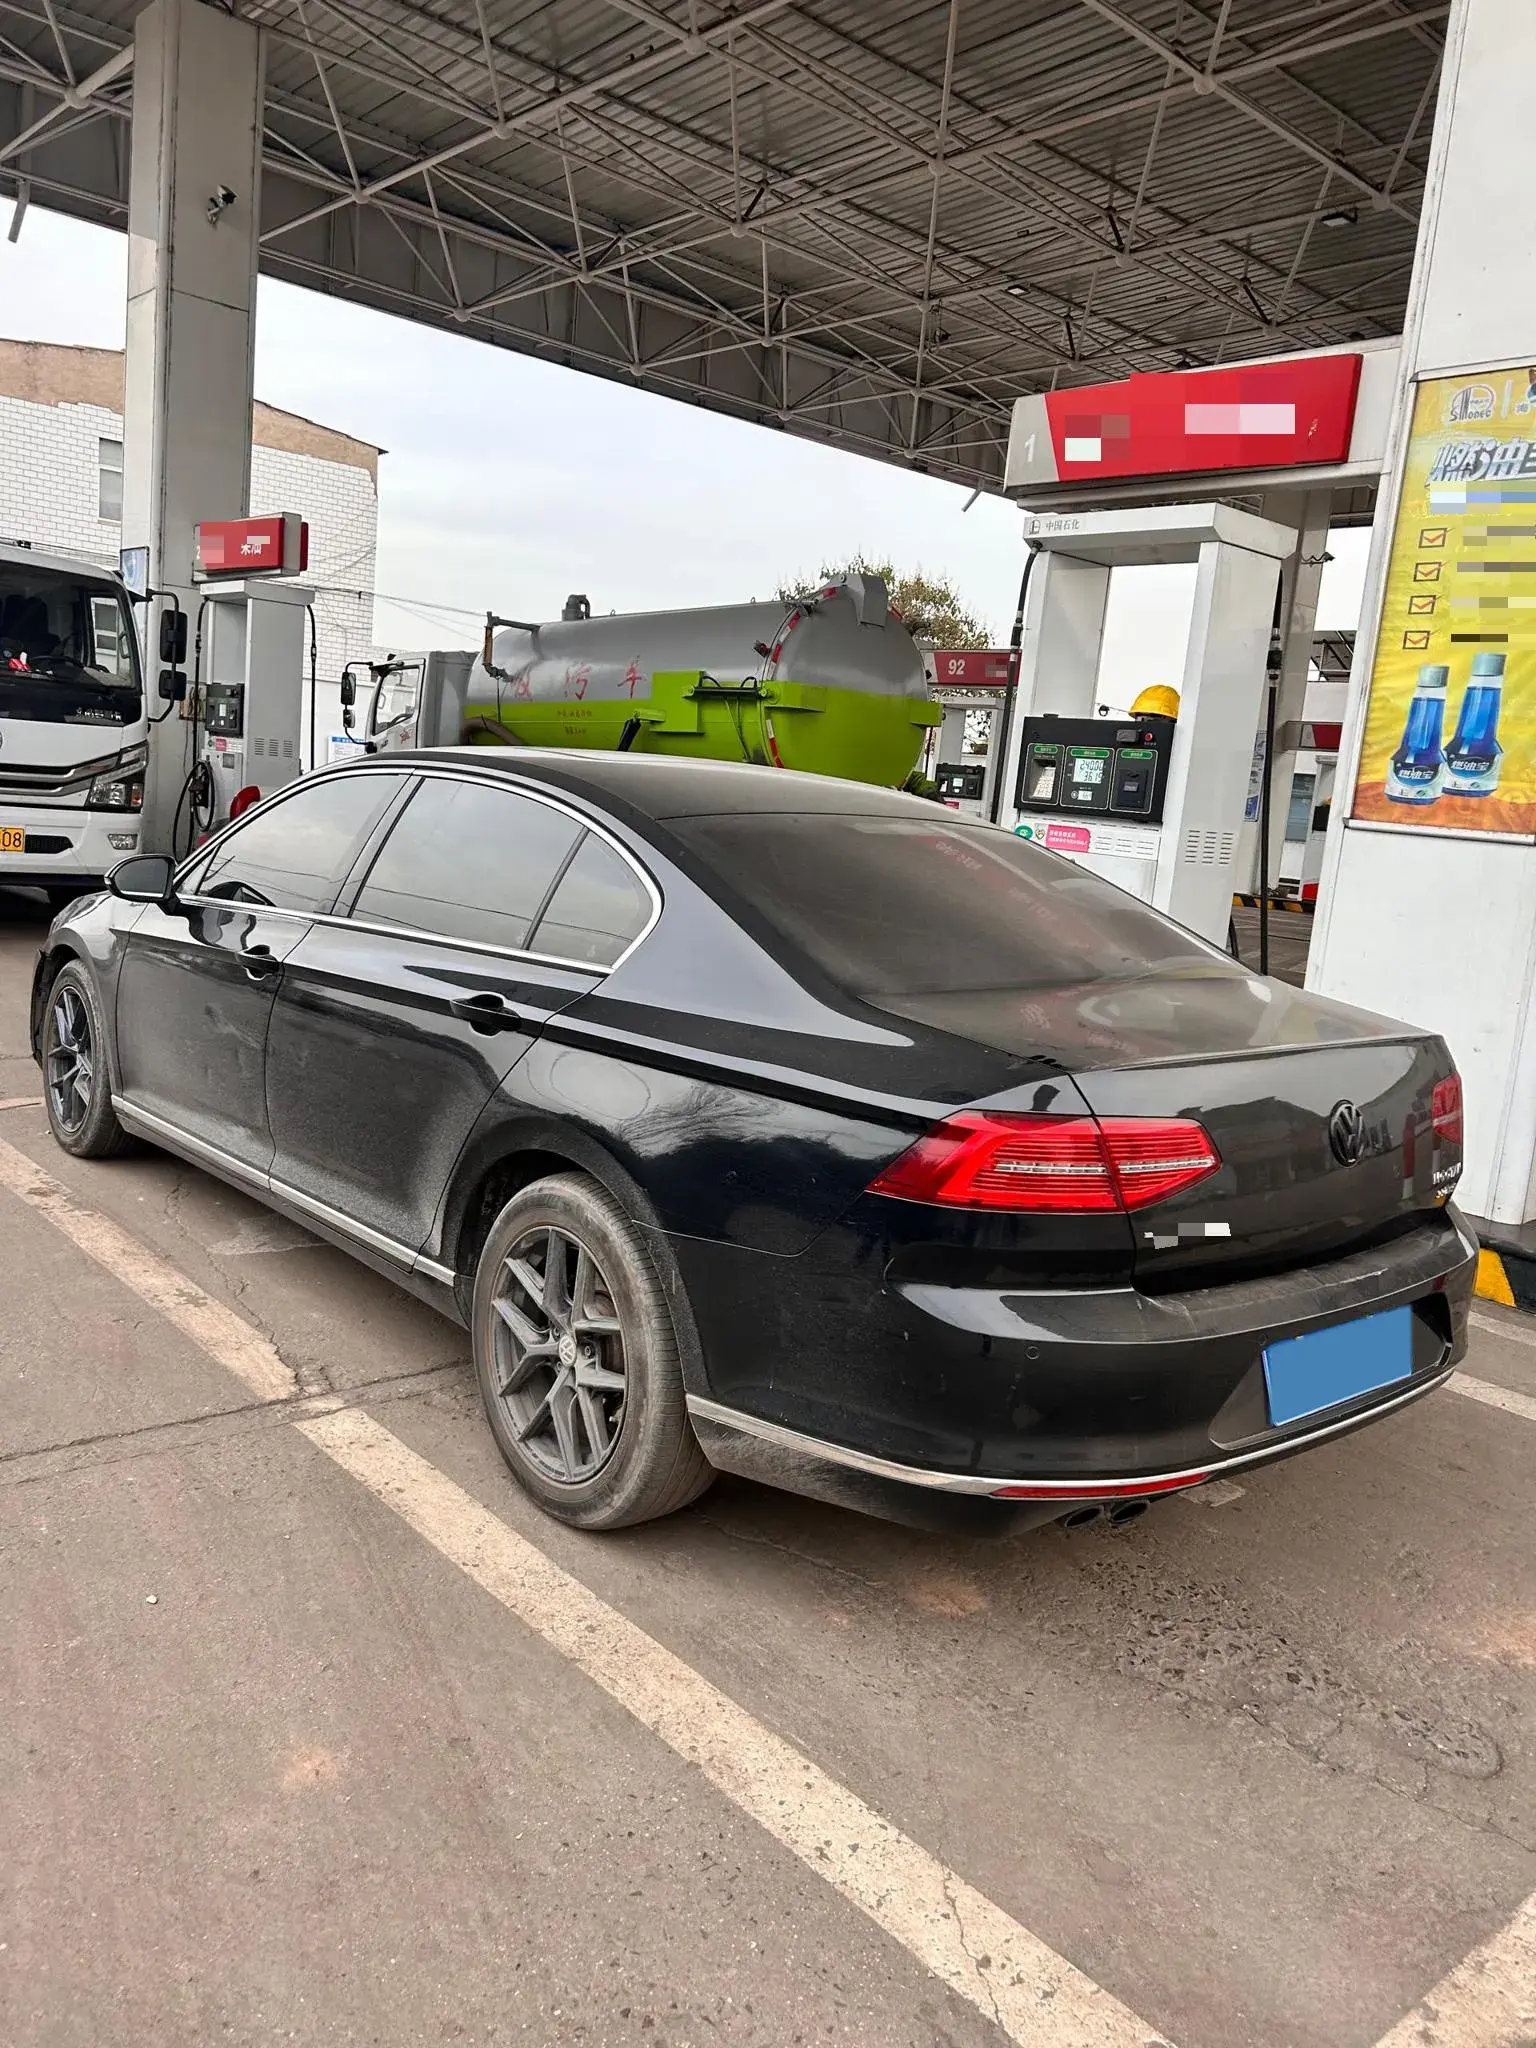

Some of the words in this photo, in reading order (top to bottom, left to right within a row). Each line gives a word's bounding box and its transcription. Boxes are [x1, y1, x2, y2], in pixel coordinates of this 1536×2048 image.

[1024, 433, 1036, 462] 1
[1045, 519, 1080, 531] 中国石化
[947, 659, 966, 675] 92
